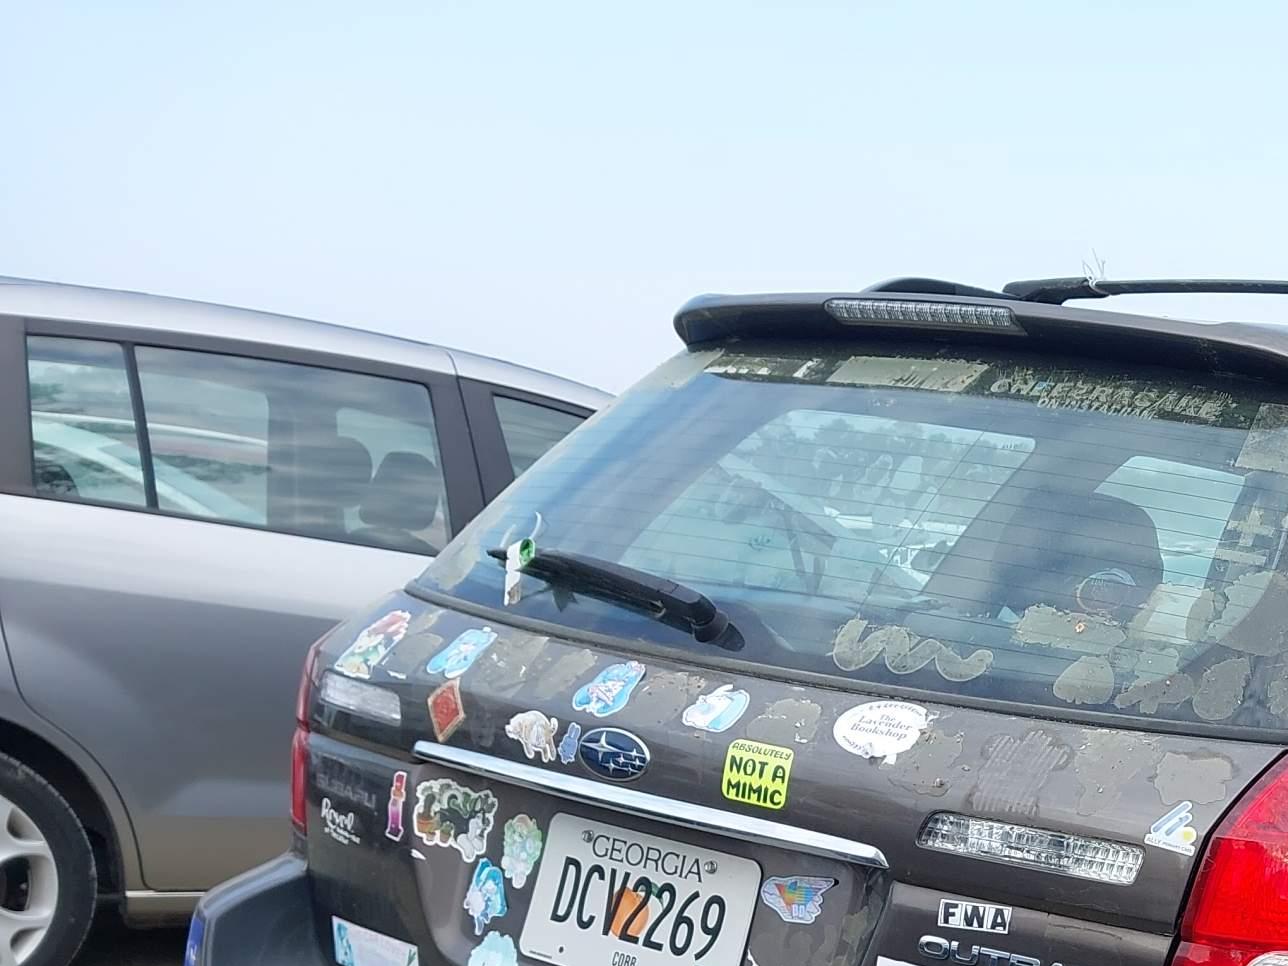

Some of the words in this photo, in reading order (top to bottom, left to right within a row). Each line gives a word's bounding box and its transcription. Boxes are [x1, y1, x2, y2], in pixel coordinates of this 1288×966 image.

[850, 722, 907, 741] Bookshop
[858, 715, 913, 731] Lavender
[732, 742, 792, 760] ABSOLUTELY
[729, 754, 768, 780] NOT
[771, 764, 786, 784] A
[726, 777, 782, 807] MIMIC
[592, 833, 703, 883] GEORGIA
[550, 856, 726, 962] DCV2269
[942, 902, 1008, 932] FWA
